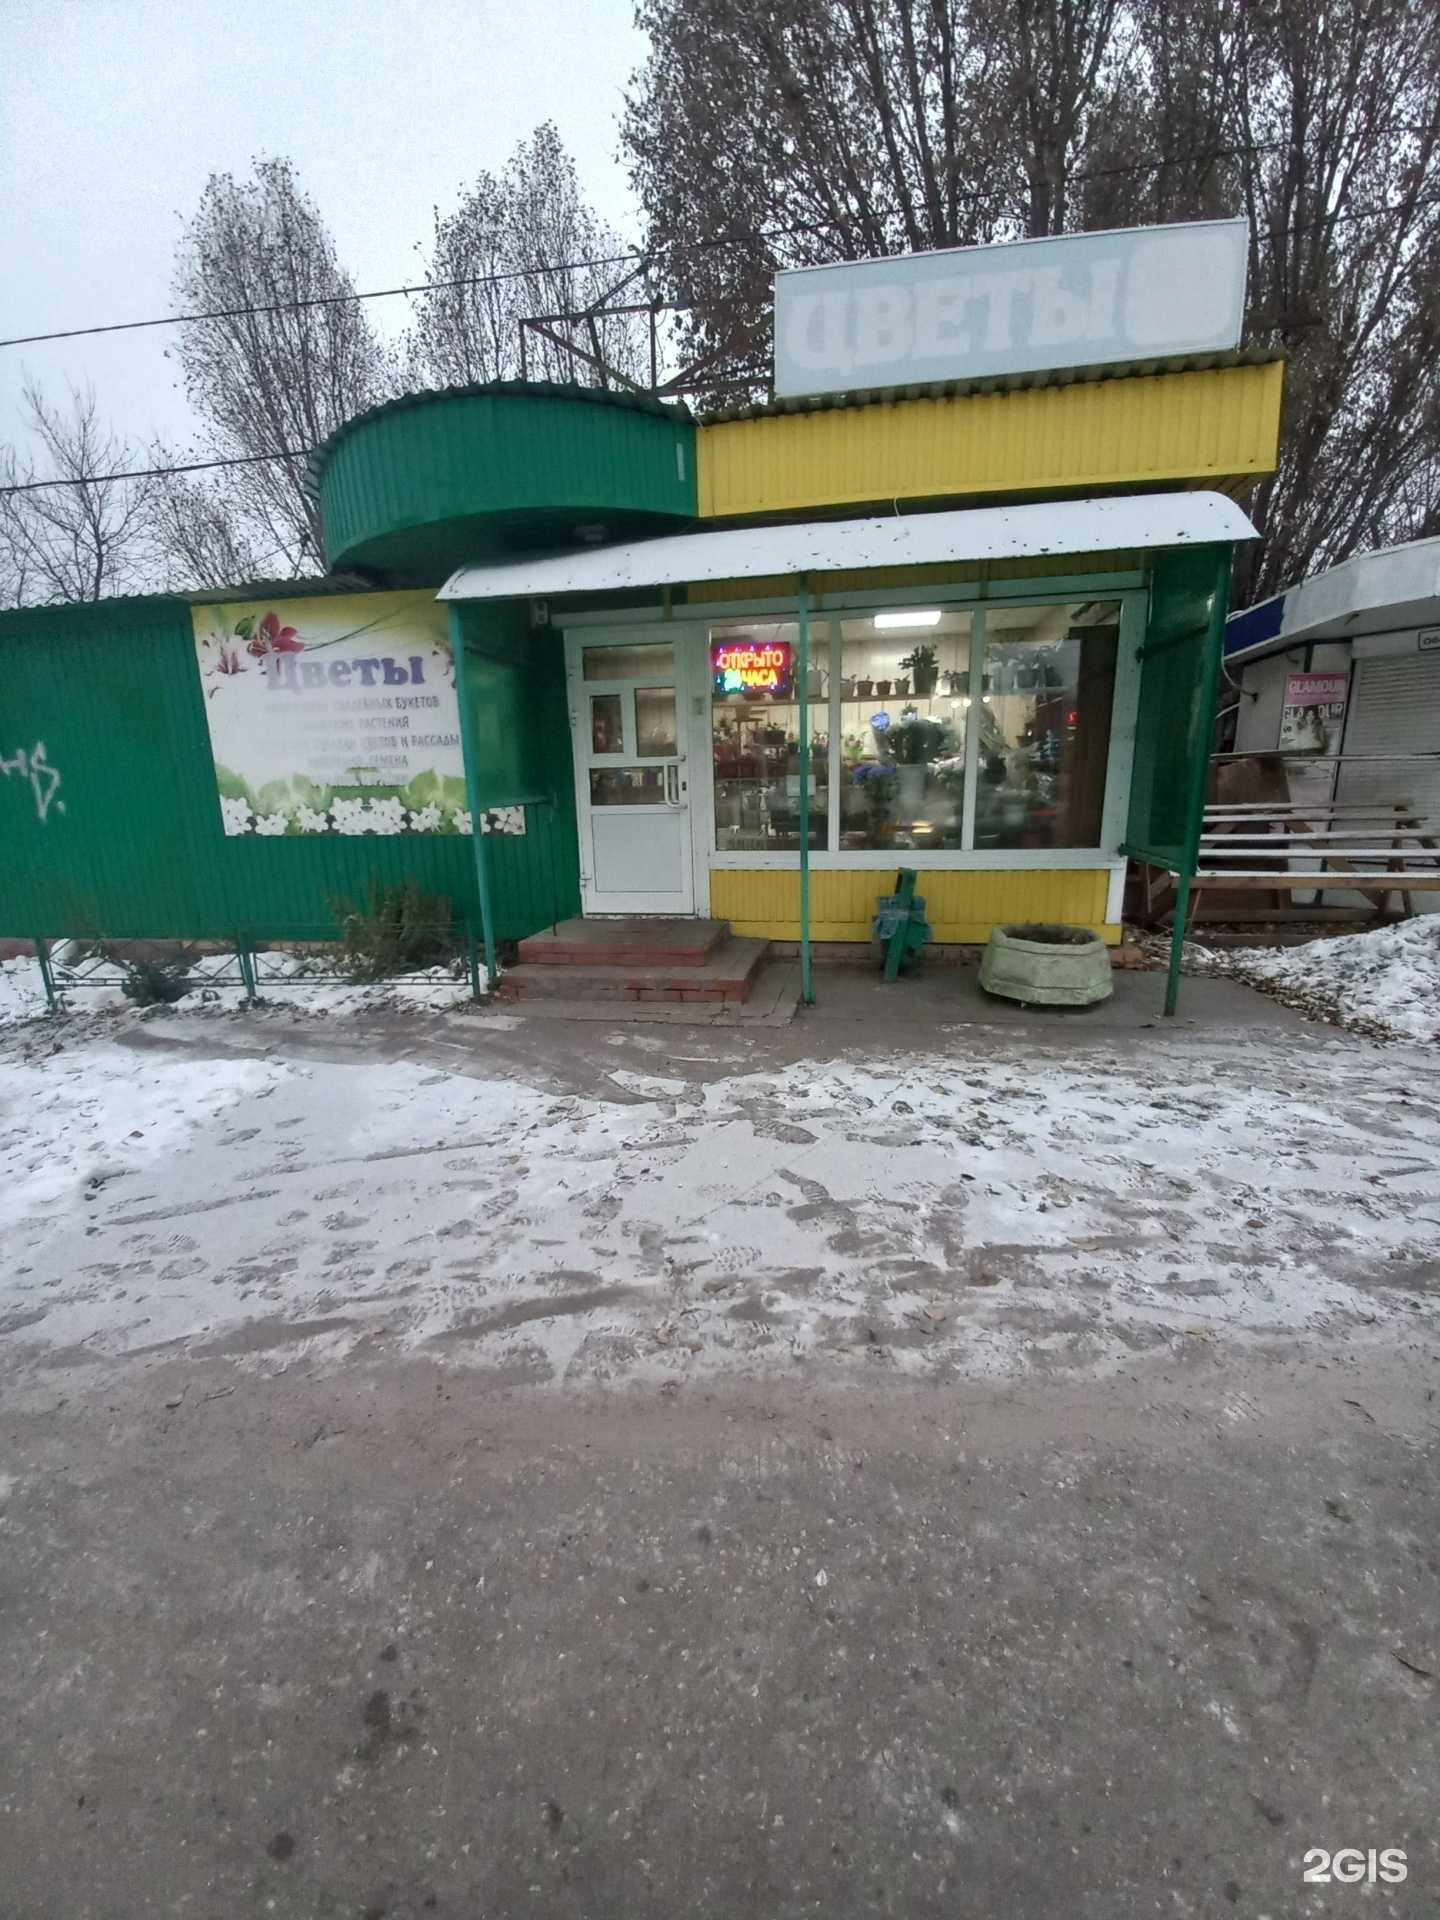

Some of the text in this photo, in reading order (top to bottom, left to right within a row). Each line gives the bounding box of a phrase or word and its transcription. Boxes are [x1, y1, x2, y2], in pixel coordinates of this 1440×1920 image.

[719, 650, 784, 669] ОТКРЫТО
[264, 652, 425, 695] Цветы
[741, 668, 778, 687] ЧАСА
[395, 695, 441, 709] БУКЕТОВ
[411, 734, 460, 747] РАССАДЫ
